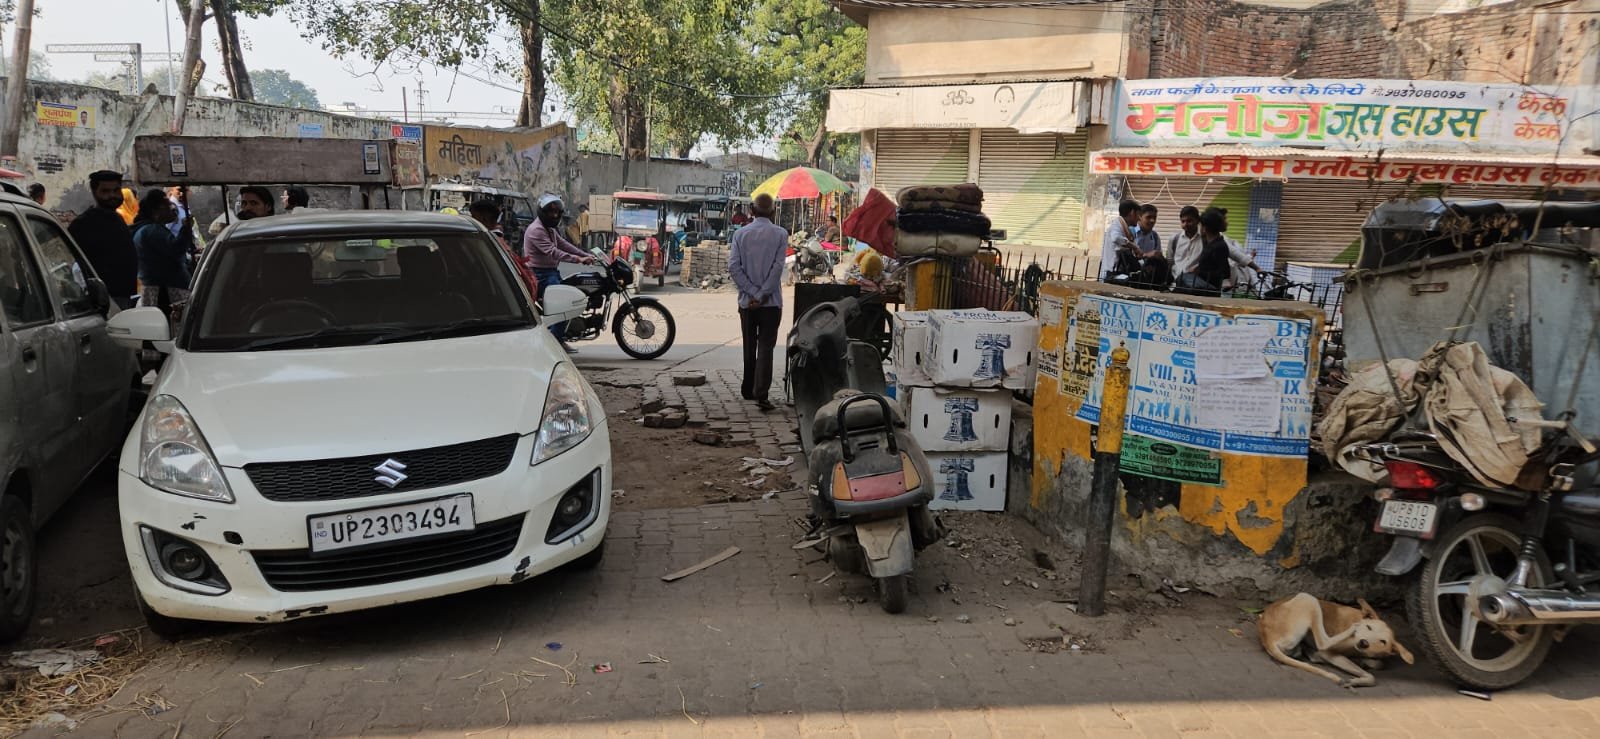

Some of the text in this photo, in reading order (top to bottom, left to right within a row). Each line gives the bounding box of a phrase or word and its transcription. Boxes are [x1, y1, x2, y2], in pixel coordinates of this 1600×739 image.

[1131, 87, 1163, 96] ताजा
[1222, 86, 1263, 95] ताजा
[1267, 86, 1296, 95] रस
[1300, 84, 1320, 95] के
[1517, 91, 1568, 115] केक
[1126, 95, 1488, 142] मनोज जूस हाउस
[1514, 116, 1561, 140] केक
[439, 134, 482, 165] महिला
[1094, 154, 1287, 175] आइसक्रीम
[1292, 156, 1388, 178] मनोज
[1390, 162, 1451, 183] जूस
[1452, 163, 1536, 183] हाउस
[1100, 302, 1132, 320] RIX
[1177, 312, 1233, 328] BRI
[1104, 316, 1136, 330] DEMY
[1276, 321, 1309, 337] BR
[1283, 379, 1301, 395] IX
[331, 504, 460, 544] UP2303494
